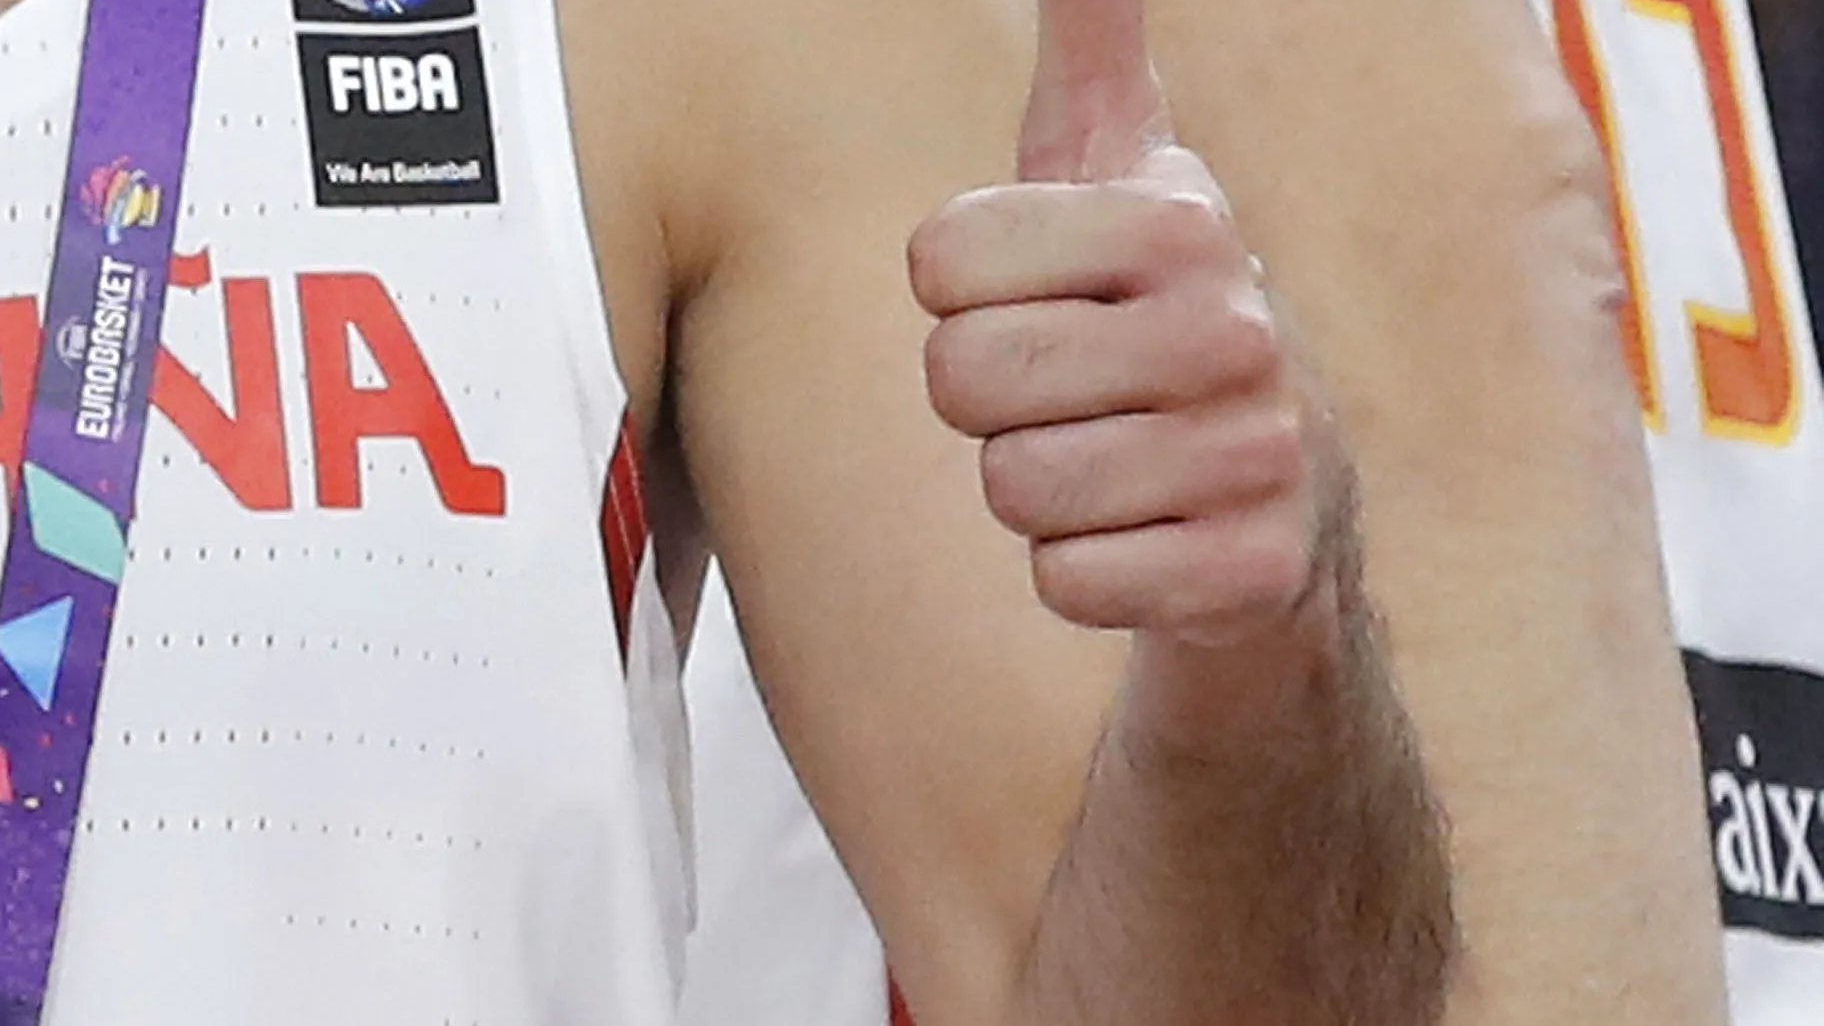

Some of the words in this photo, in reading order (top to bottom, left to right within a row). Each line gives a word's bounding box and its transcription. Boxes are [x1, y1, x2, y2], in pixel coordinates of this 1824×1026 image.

[327, 52, 460, 113] FIBA
[76, 255, 135, 439] EUROBASKET
[1707, 732, 1824, 906] aix
